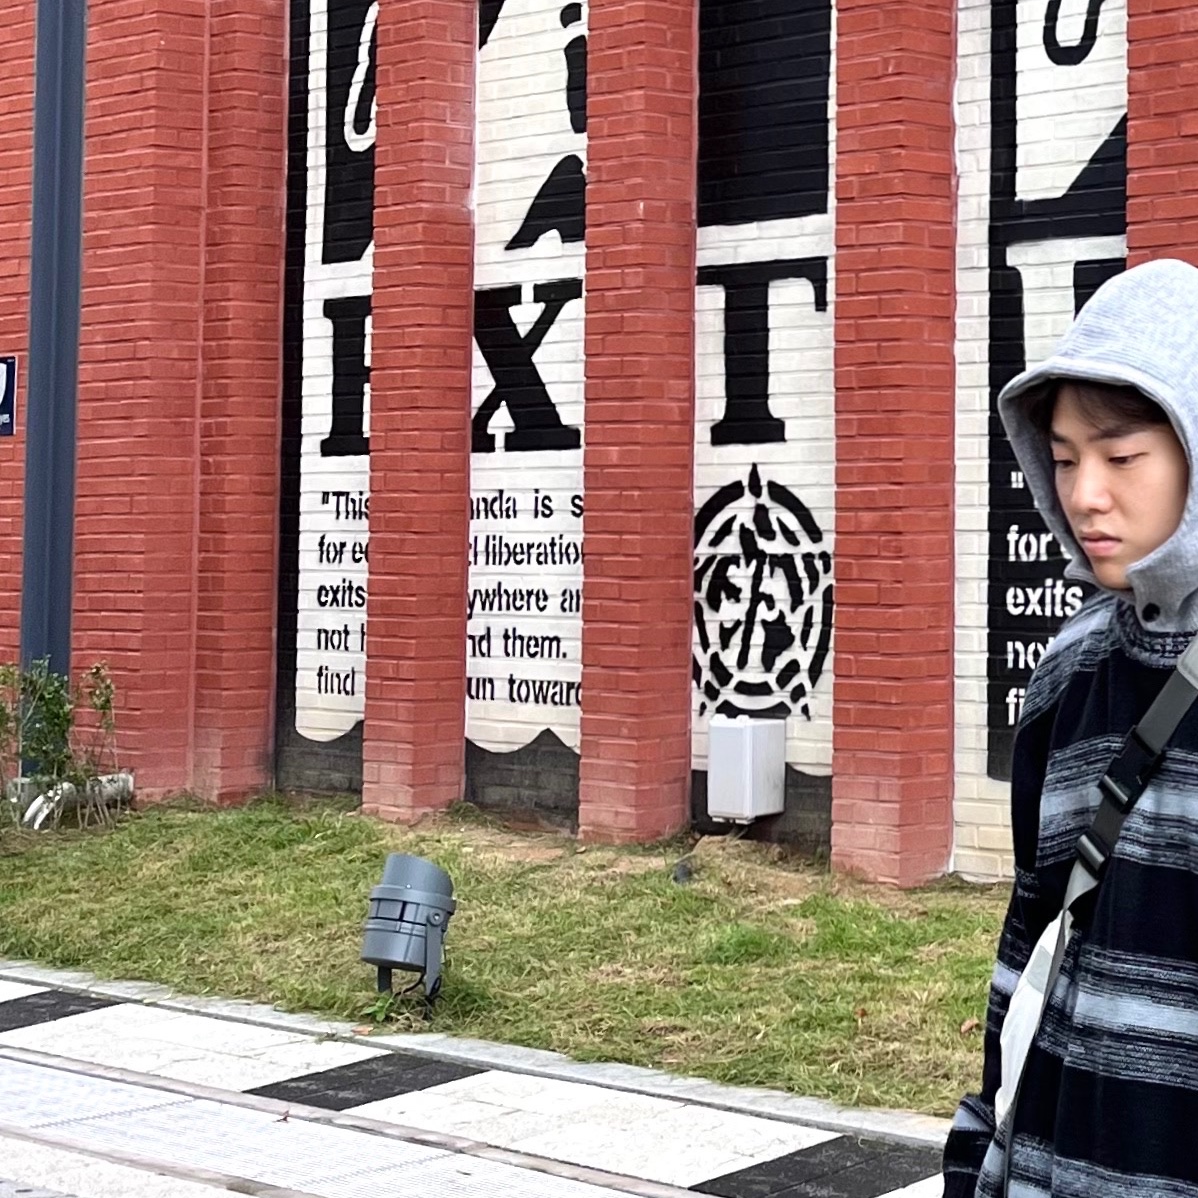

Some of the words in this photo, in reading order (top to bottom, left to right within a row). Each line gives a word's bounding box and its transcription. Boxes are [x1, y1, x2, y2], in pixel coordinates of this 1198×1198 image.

[534, 488, 553, 519] is
[318, 533, 346, 564] for
[486, 534, 584, 566] liberatio
[1006, 524, 1054, 562] for
[317, 577, 366, 607] exits
[467, 581, 549, 620] ywhere
[1006, 578, 1083, 617] exits
[317, 624, 350, 651] not
[503, 627, 567, 658] them.
[317, 665, 355, 696] find
